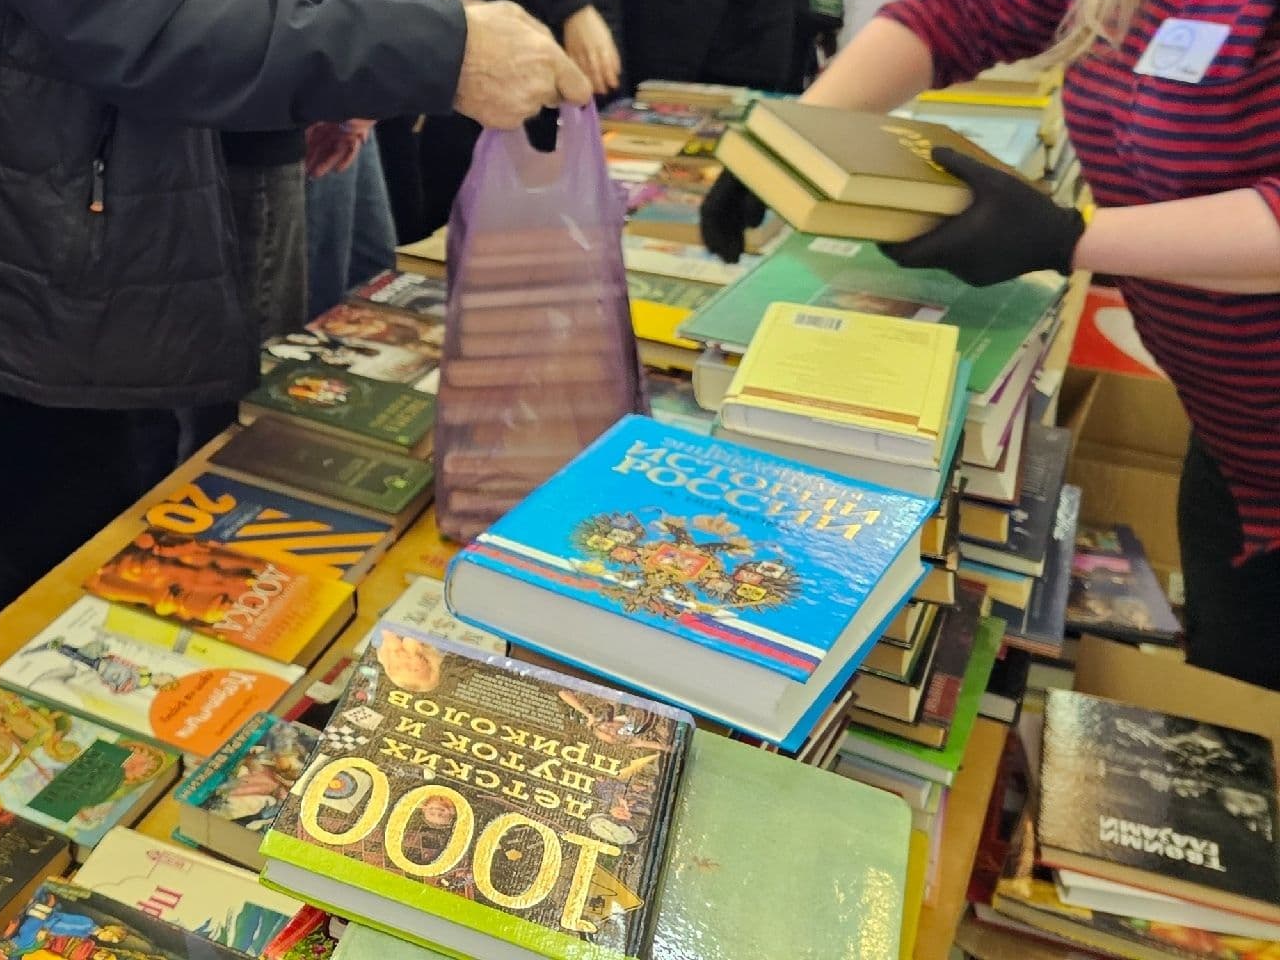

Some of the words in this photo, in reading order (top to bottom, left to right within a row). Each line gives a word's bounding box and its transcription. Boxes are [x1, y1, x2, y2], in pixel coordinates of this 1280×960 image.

[146, 483, 237, 534] 20
[612, 456, 863, 541] РОССИИ
[626, 440, 881, 525] ИСТОРИИ
[386, 690, 623, 776] приколов
[394, 716, 426, 739] и
[441, 729, 596, 794] шуток
[380, 737, 593, 820] детских
[300, 757, 622, 934] 1000
